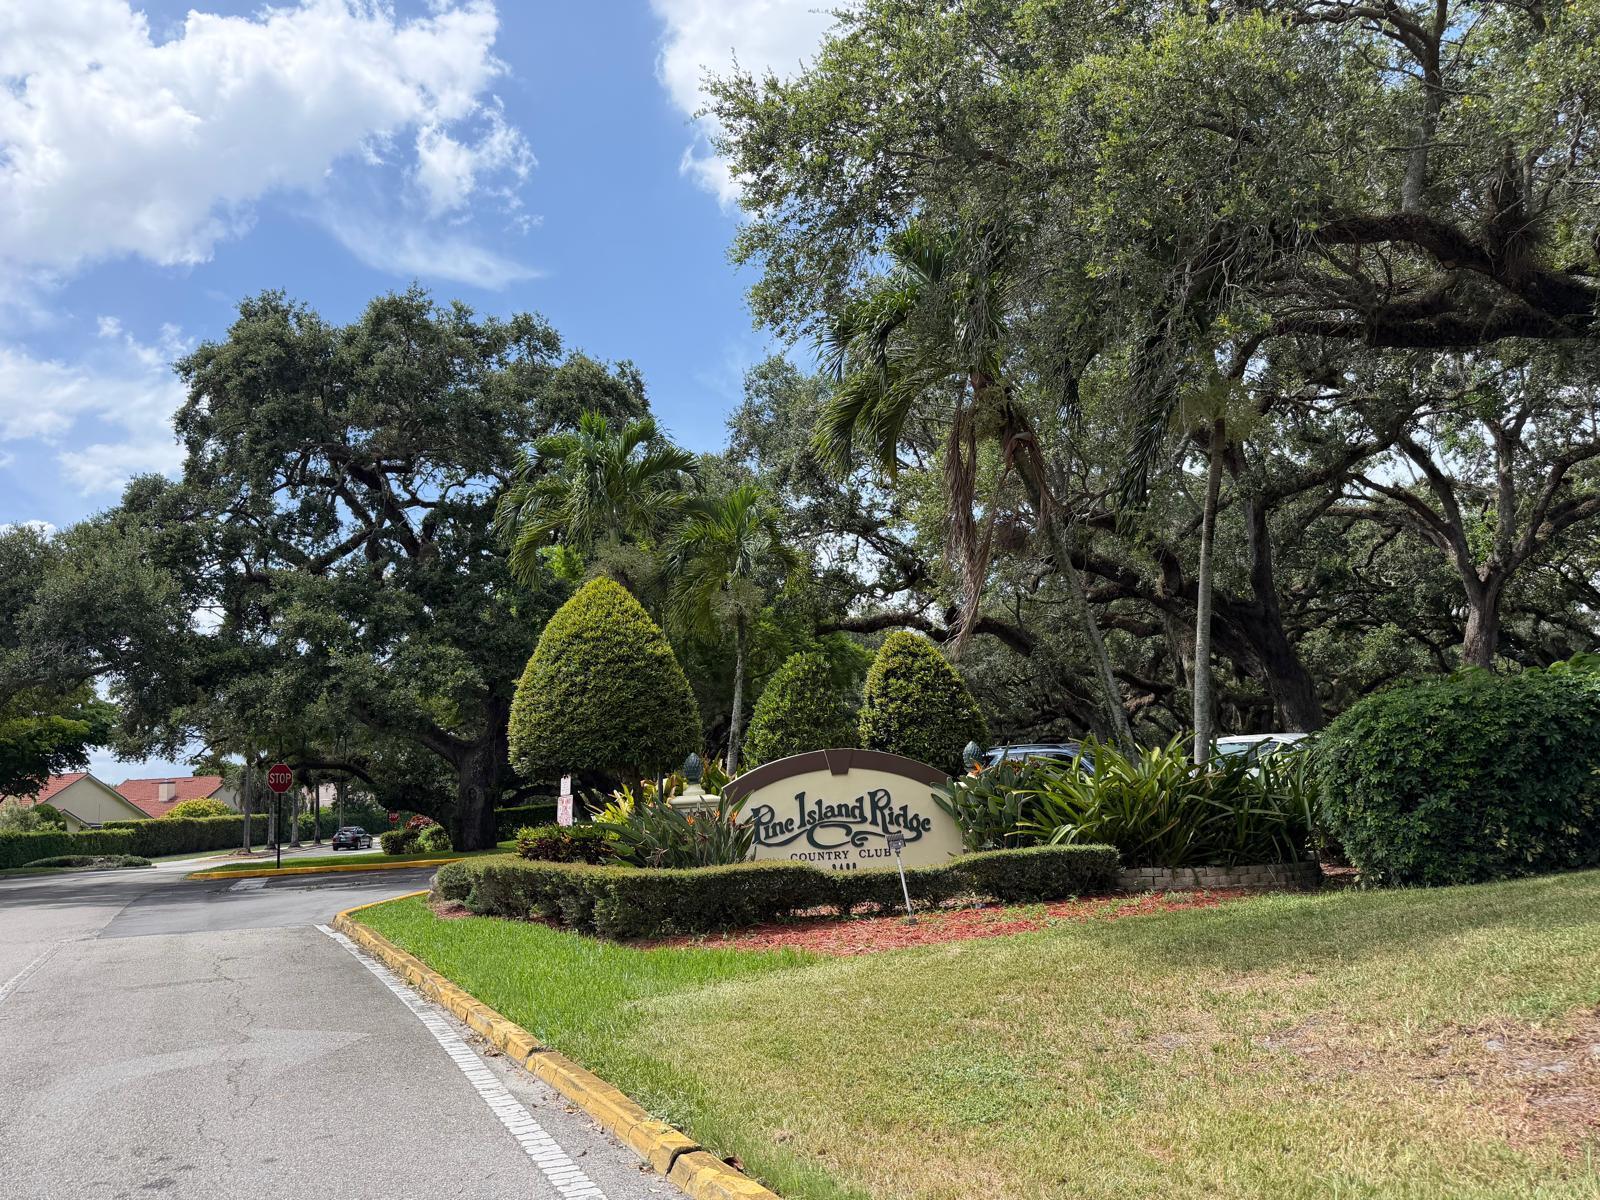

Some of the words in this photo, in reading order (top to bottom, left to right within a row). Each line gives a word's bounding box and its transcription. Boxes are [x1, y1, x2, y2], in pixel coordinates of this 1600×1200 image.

[269, 773, 292, 784] STOP
[751, 804, 794, 846] Pine
[795, 791, 867, 829] Island
[868, 789, 931, 842] Ridge
[790, 850, 849, 861] COUNTRY
[858, 848, 892, 858] CLUB
